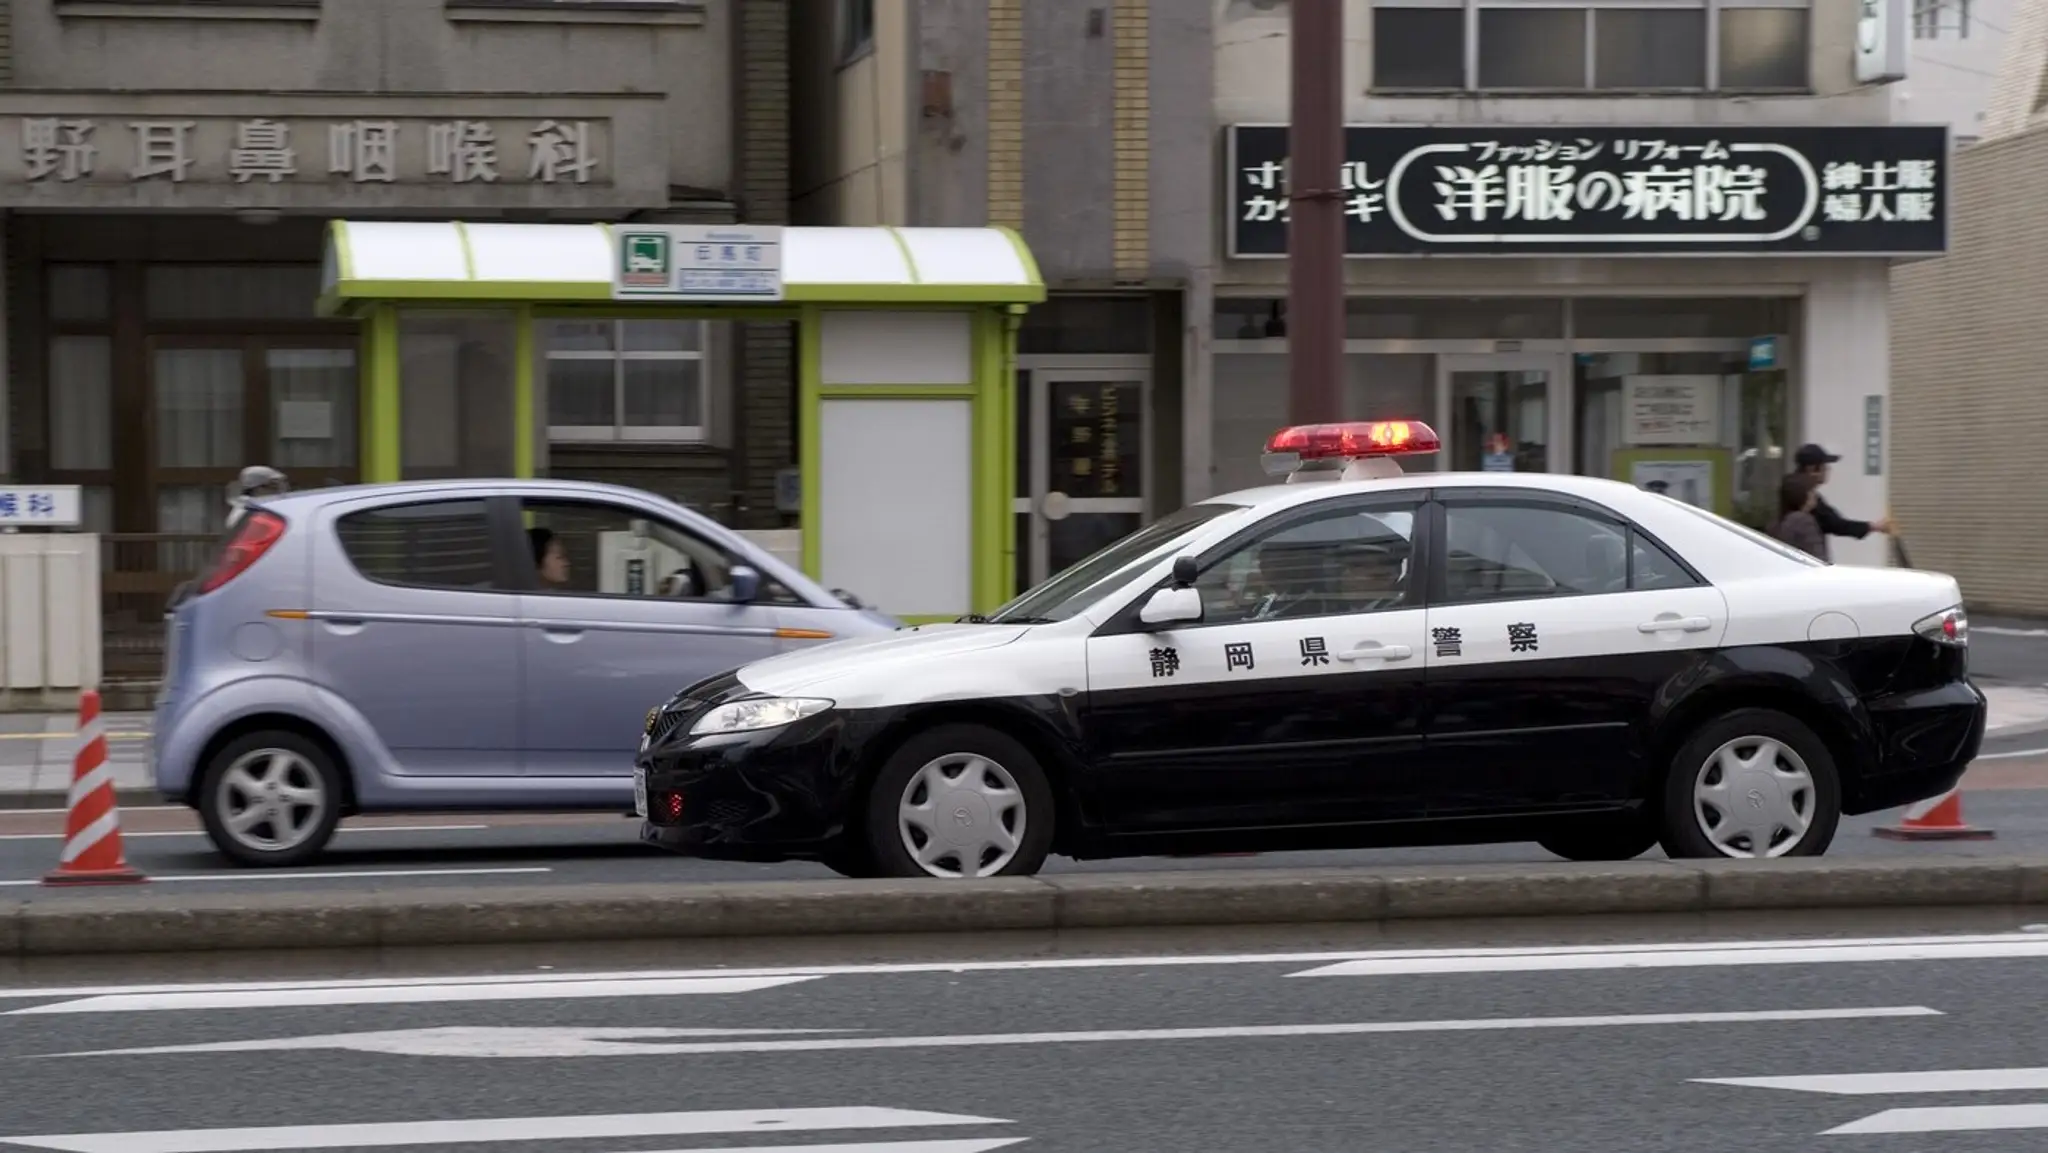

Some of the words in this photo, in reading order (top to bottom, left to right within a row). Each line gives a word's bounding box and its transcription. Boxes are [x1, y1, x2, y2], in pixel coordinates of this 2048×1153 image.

[22, 117, 599, 184] 野耳鼻咽喉科
[1469, 138, 1604, 163] ファッション
[1613, 138, 1730, 162] リフォーム
[1433, 163, 1768, 222] 洋服の病院
[1822, 159, 1937, 190] 紳士服
[1822, 192, 1936, 222] 婦人服
[1148, 636, 1330, 678] 静岡県
[1431, 621, 1539, 658] 警察
